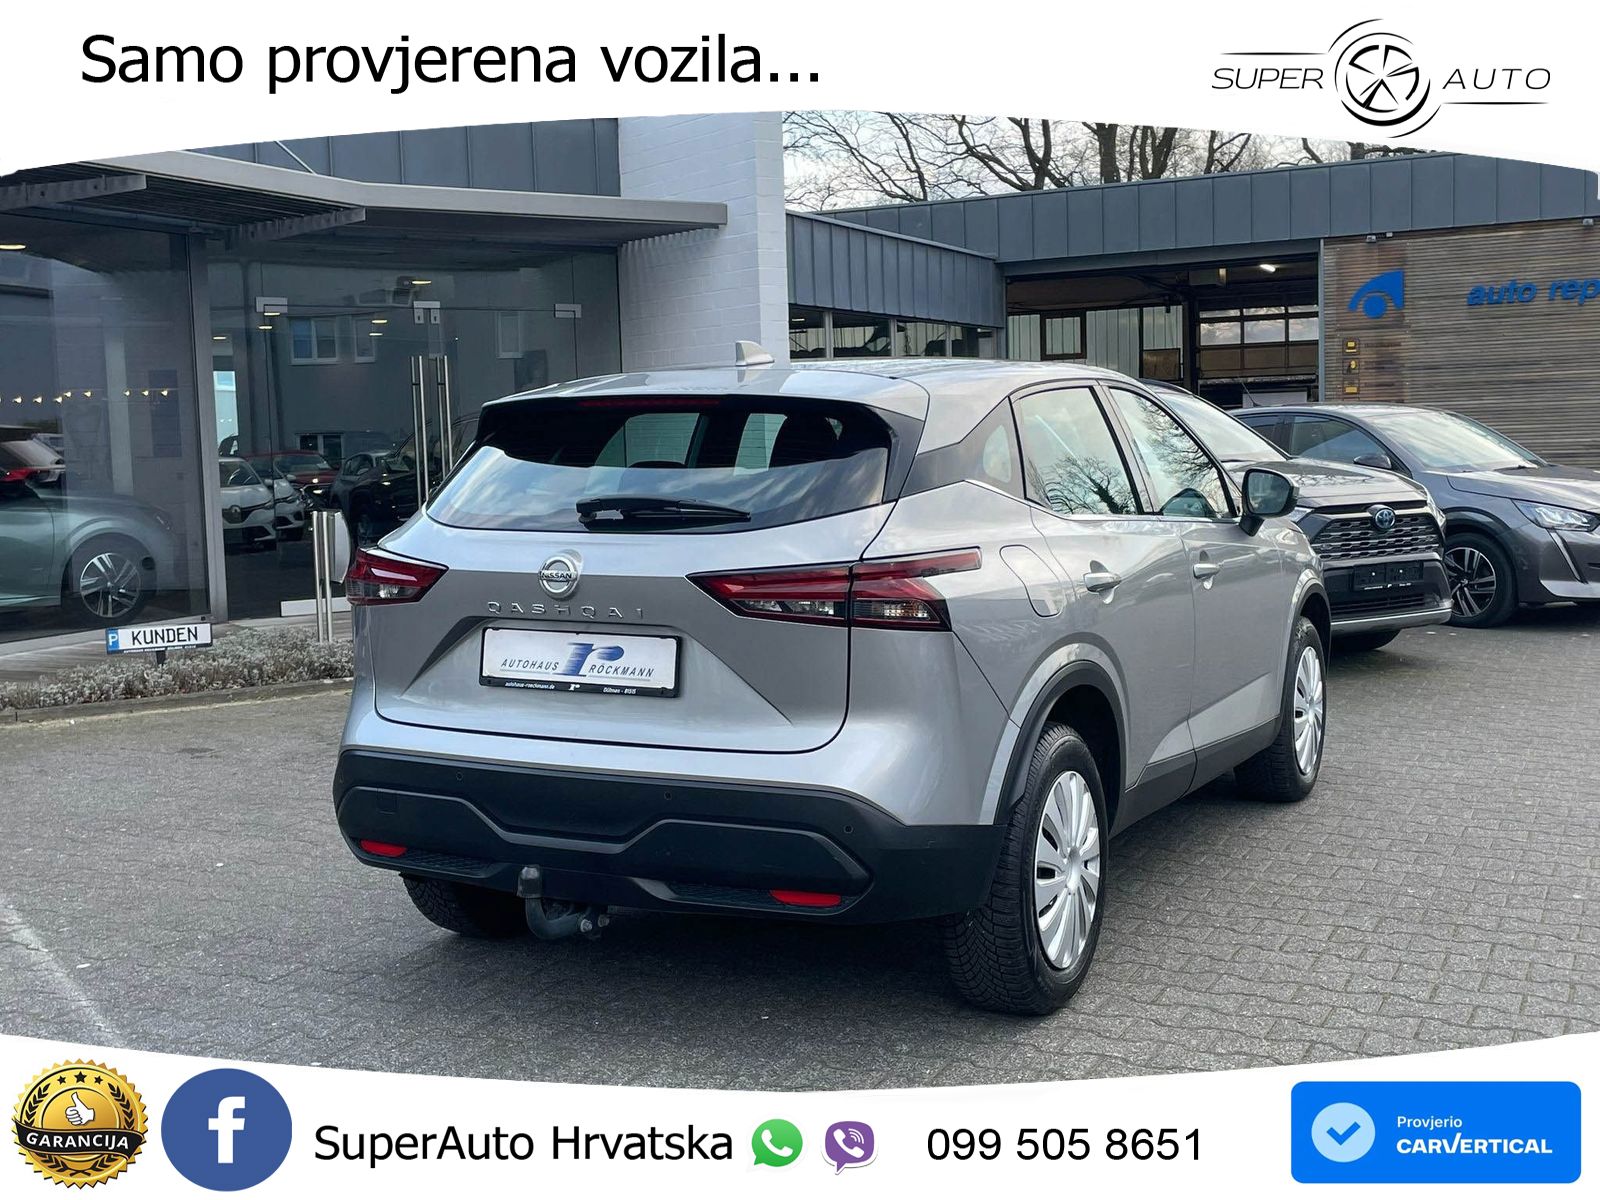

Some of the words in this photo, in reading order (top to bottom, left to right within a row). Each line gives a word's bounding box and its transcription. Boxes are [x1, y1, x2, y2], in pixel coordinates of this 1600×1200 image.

[1467, 281, 1536, 305] auto
[541, 572, 572, 580] NISSAN
[487, 601, 644, 619] QASHQAI
[108, 633, 118, 646] P
[131, 626, 198, 645] KUNDEN
[501, 658, 560, 671] AUTOHAUS
